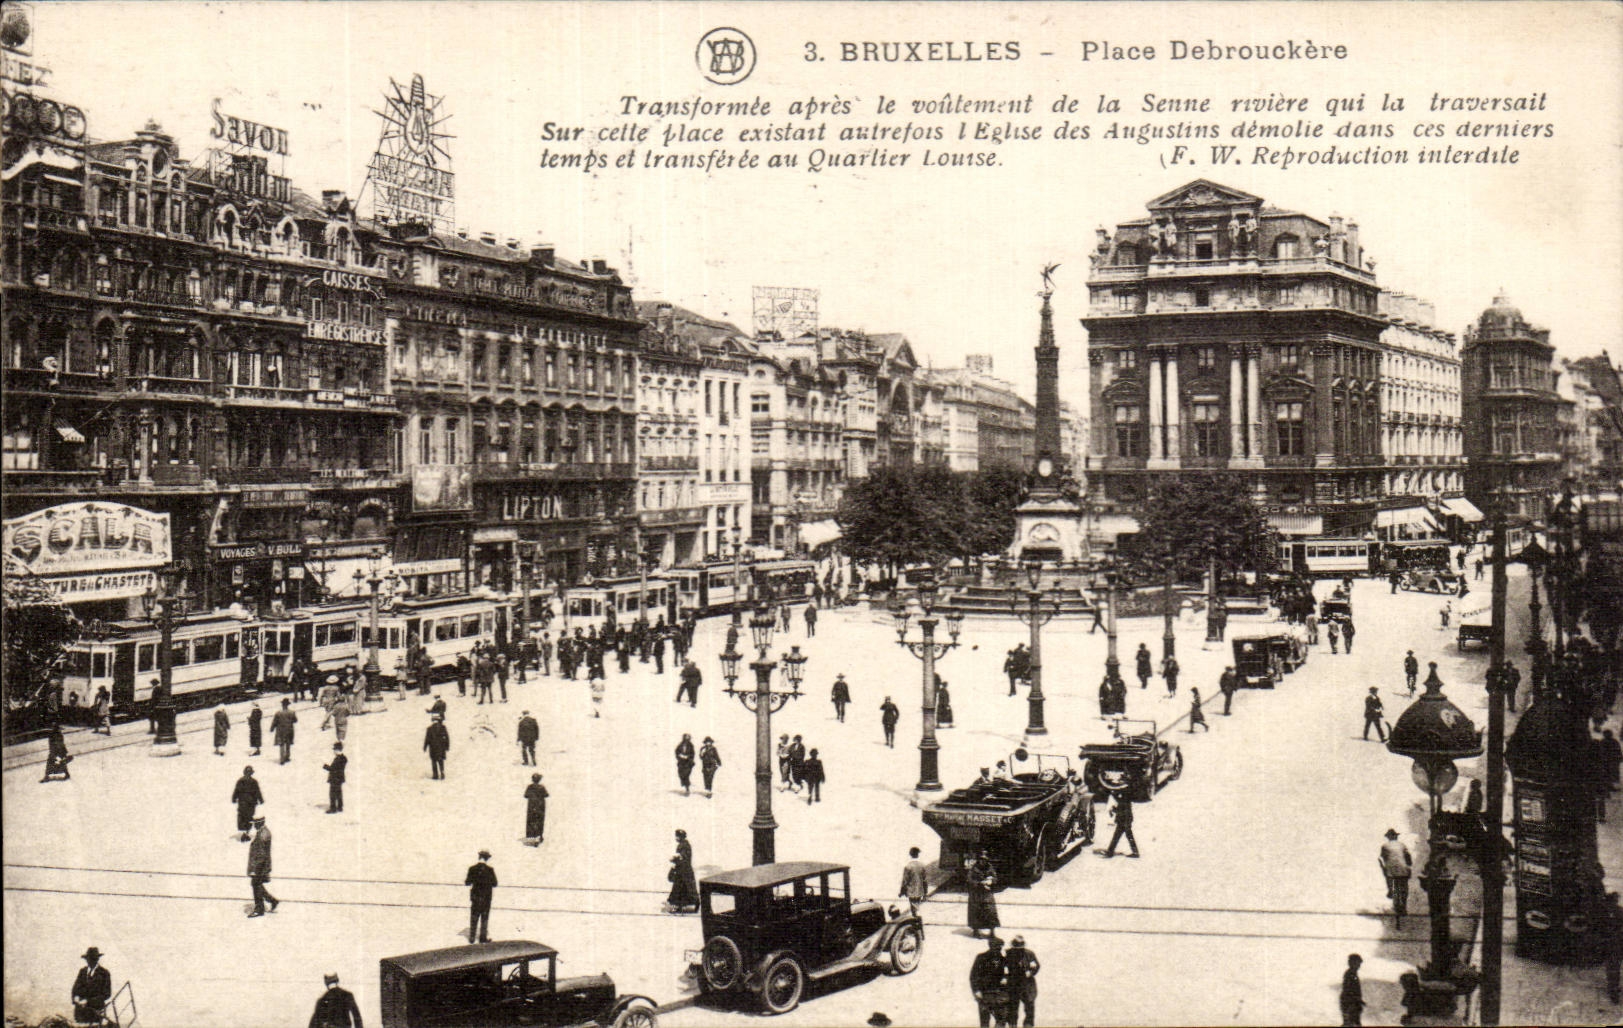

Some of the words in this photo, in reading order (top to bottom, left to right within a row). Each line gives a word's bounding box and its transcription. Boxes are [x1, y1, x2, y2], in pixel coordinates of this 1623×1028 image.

[322, 270, 372, 292] CAISSES
[502, 495, 564, 521] LIPTON
[11, 515, 153, 565] SCALA
[220, 547, 257, 559] VOYAGES
